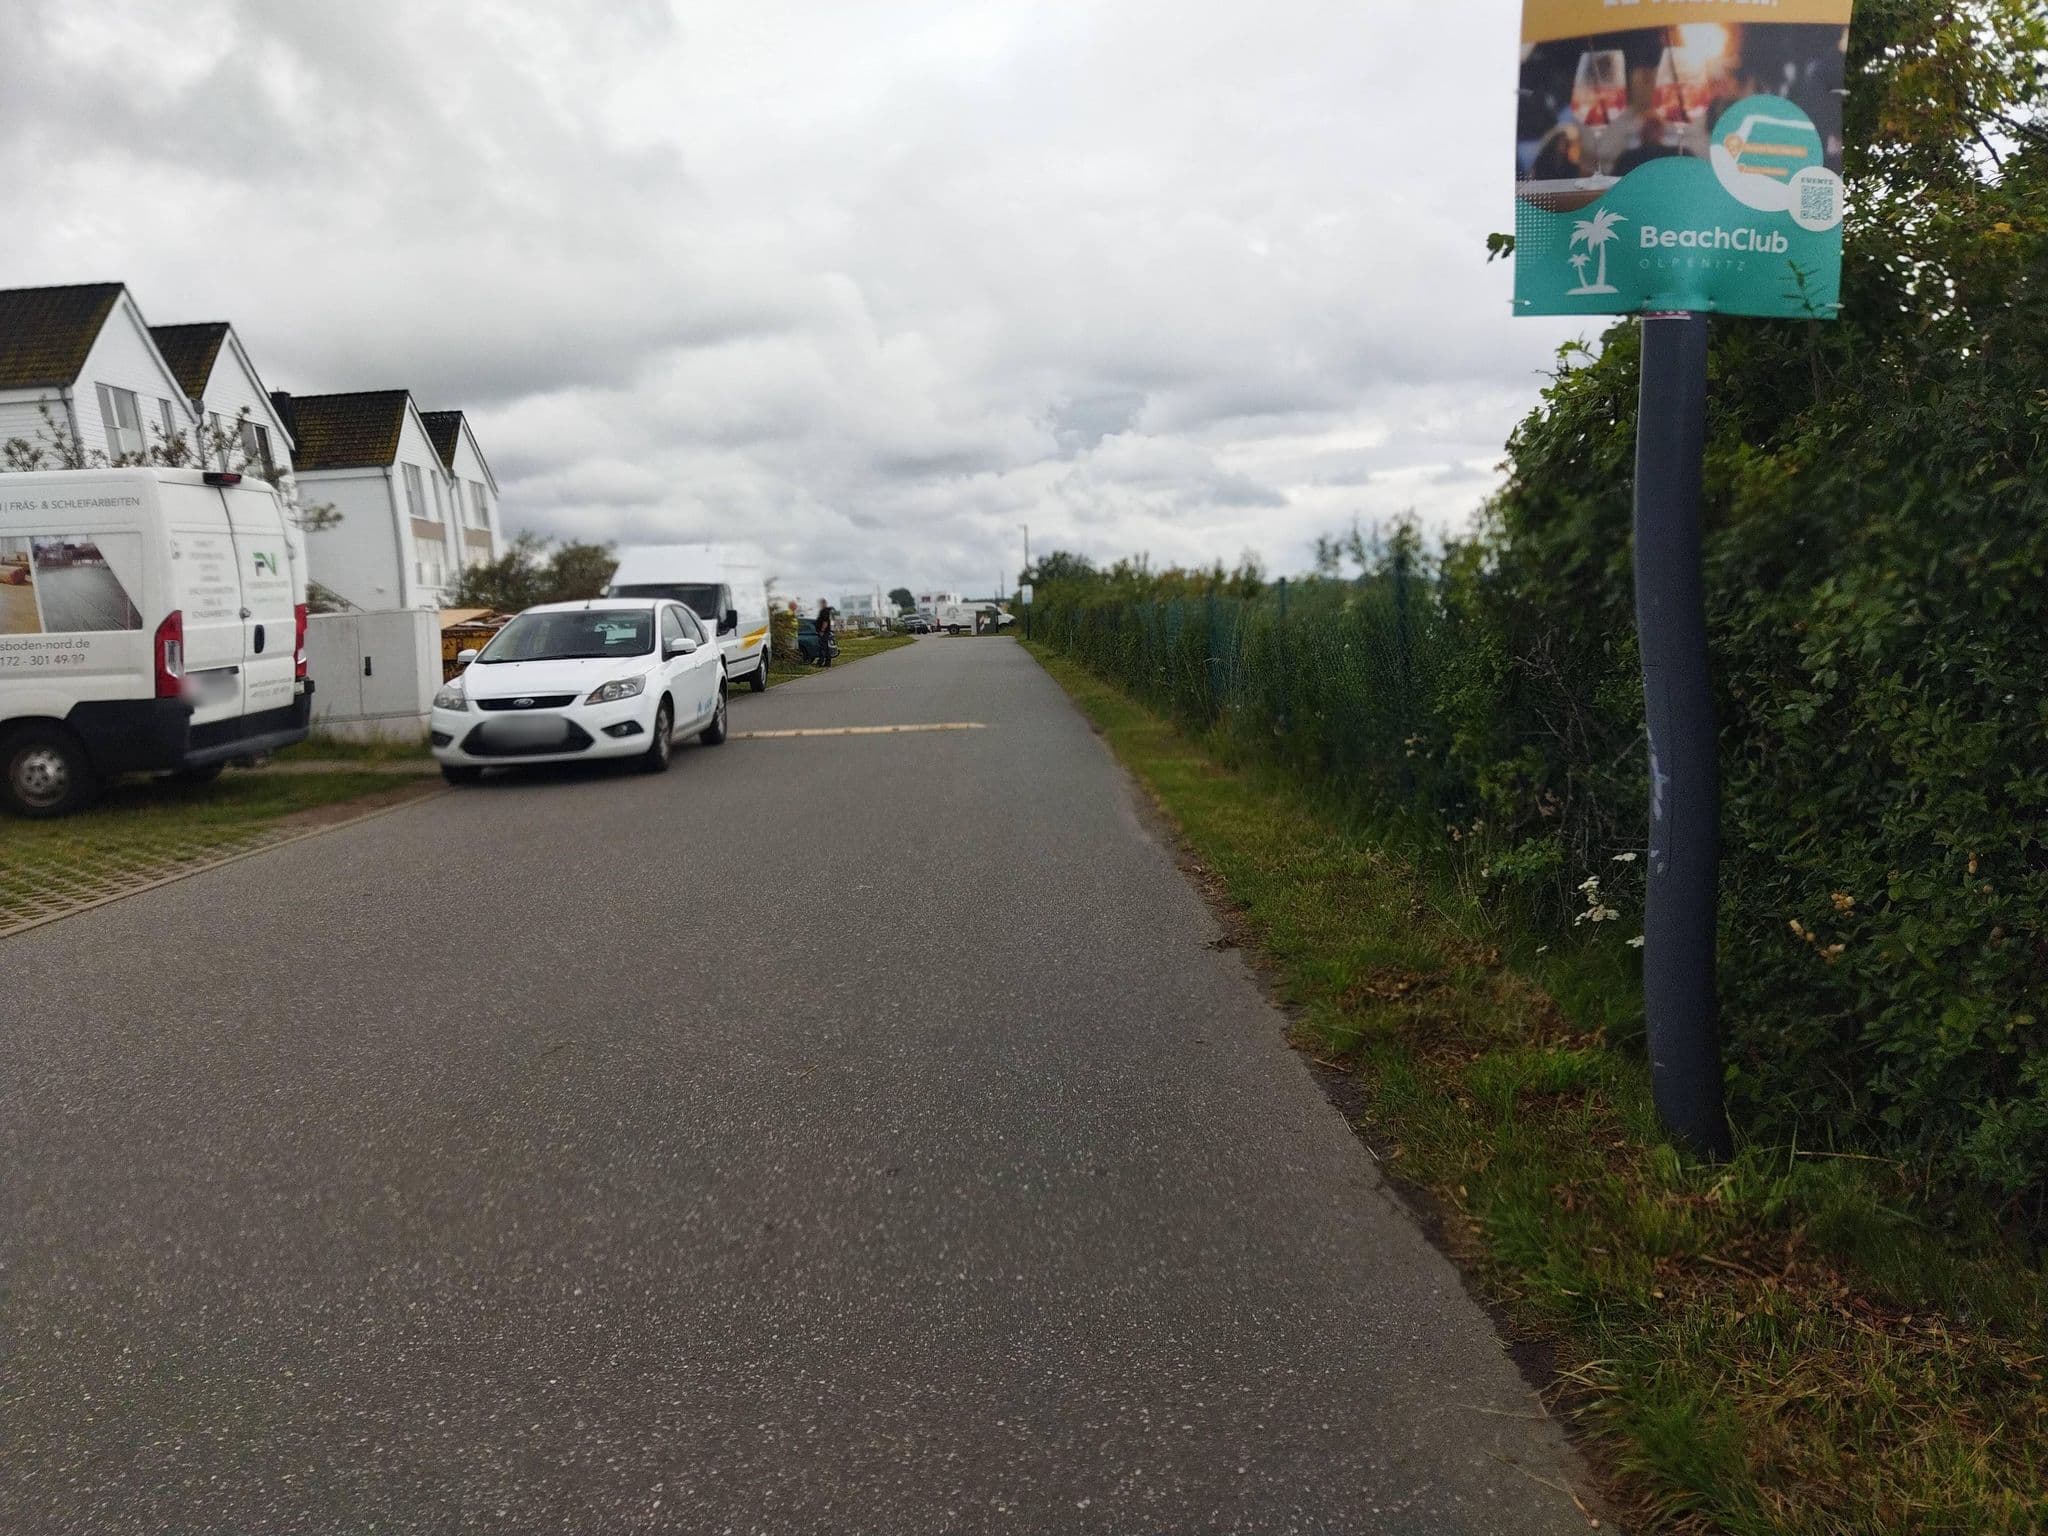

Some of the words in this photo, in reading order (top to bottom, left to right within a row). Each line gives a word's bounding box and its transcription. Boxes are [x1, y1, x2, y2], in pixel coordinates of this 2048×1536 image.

[1640, 226, 1788, 253] BeachClub
[1640, 257, 1746, 271] OLPENITZ
[41, 500, 49, 510] &
[51, 497, 140, 509] SCHLEIFARBEITEN
[30, 655, 50, 666] 301
